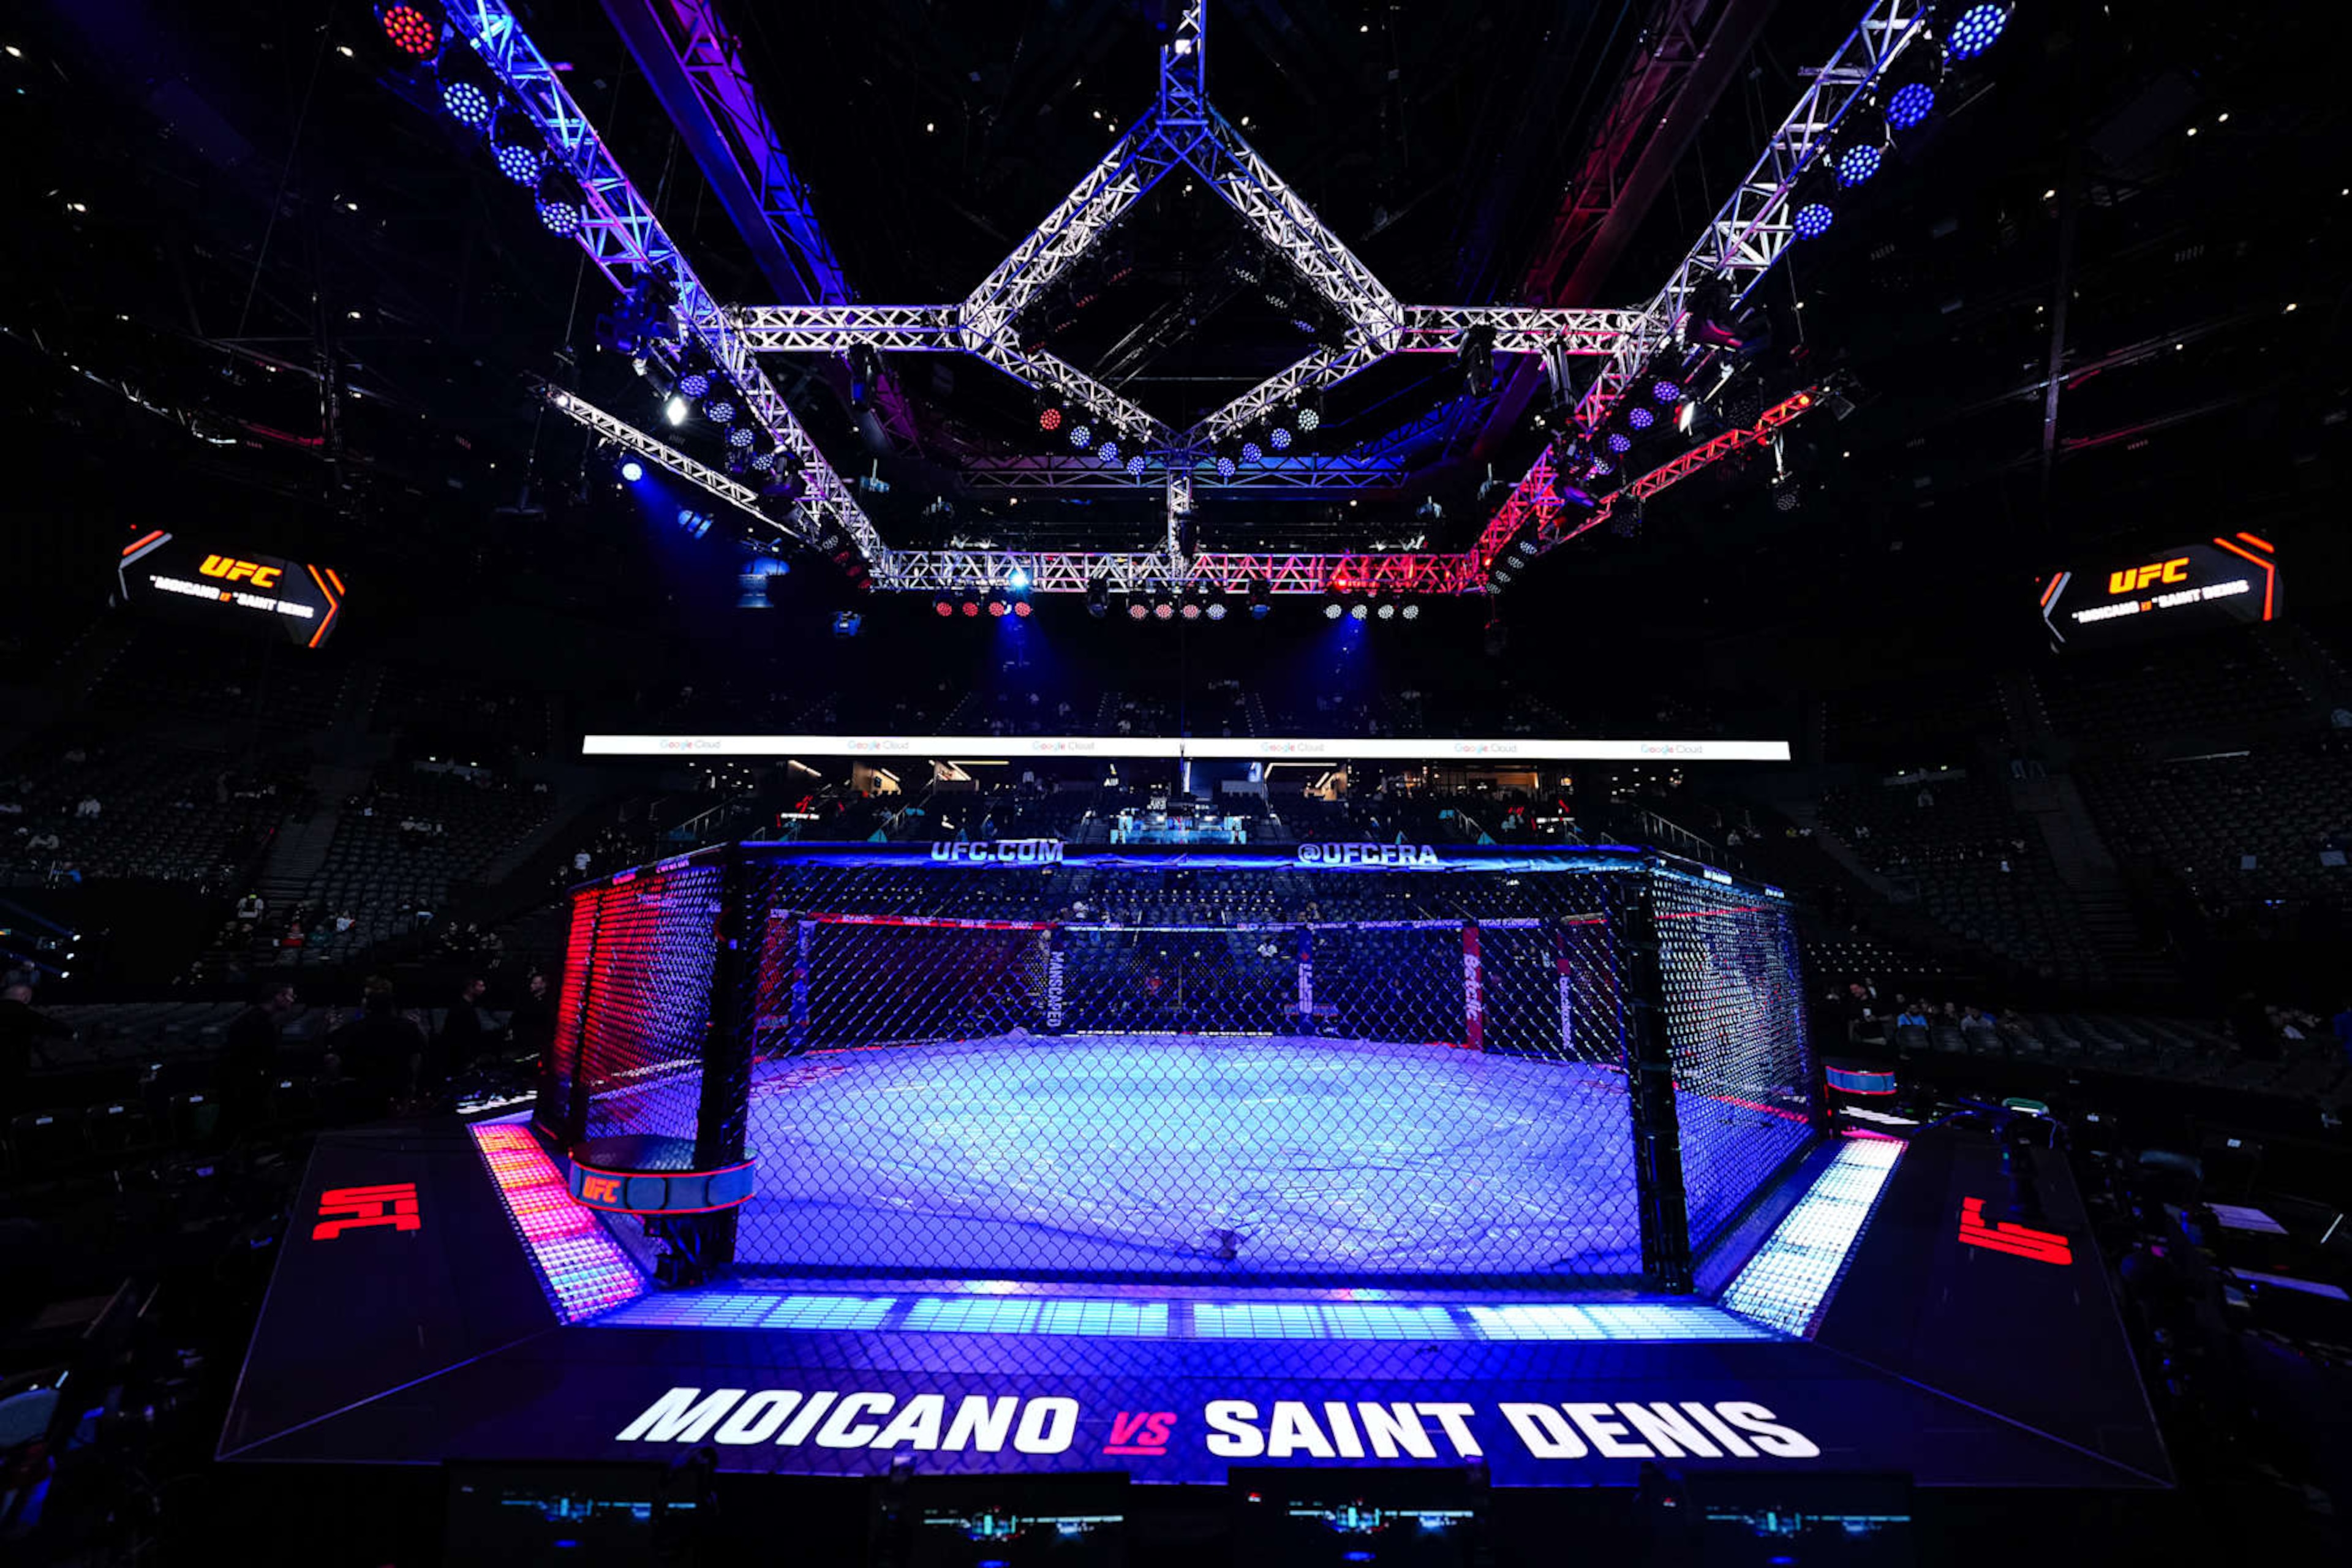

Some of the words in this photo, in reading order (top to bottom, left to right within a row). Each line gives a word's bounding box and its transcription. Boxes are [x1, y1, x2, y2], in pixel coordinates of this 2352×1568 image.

[200, 554, 283, 588] UFC
[2109, 557, 2190, 594] UFC
[660, 739, 693, 750] Google
[695, 739, 721, 749] Cloud
[848, 740, 880, 751] Google
[883, 740, 910, 749] Cloud
[1032, 741, 1065, 752] Google
[1068, 741, 1095, 750] Cloud
[1261, 742, 1295, 753] Google
[1297, 742, 1324, 752] Cloud
[1454, 742, 1488, 753] Google
[1491, 742, 1517, 752] Cloud
[1641, 743, 1673, 755] Google
[1676, 744, 1703, 753] Cloud
[930, 840, 1065, 861] UFC.COM
[1297, 842, 1439, 865] @UFCFRA
[1046, 950, 1065, 1028] MANSCAPED
[582, 1176, 621, 1204] UFC
[615, 1387, 1080, 1454] MOICANO
[1109, 1411, 1177, 1446] VS
[1205, 1400, 1483, 1458] SAINT
[1498, 1401, 1820, 1460] DENIS
